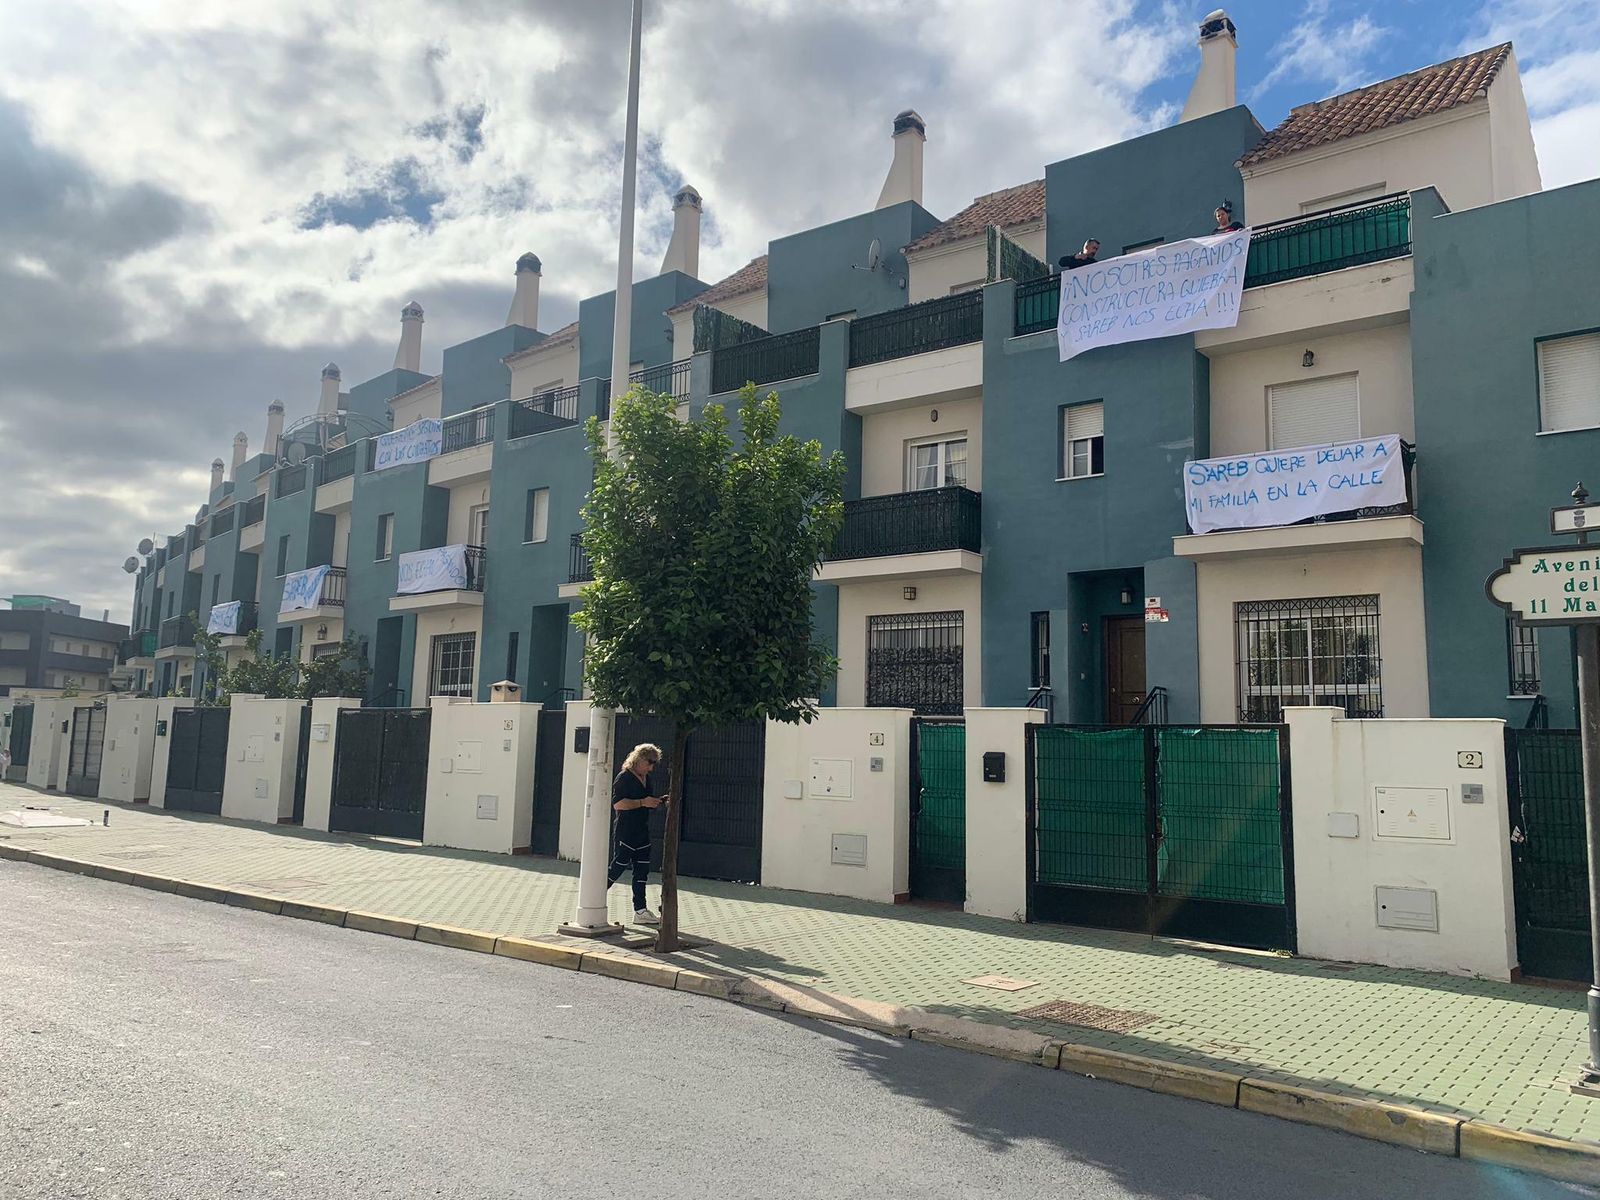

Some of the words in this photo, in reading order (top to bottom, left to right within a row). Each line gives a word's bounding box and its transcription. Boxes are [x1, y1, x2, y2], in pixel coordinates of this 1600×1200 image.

[1173, 238, 1243, 272] PAGAMOS
[1062, 281, 1174, 325] CONSTRUCTORA
[1122, 307, 1156, 328] NOS
[1165, 298, 1208, 320] ECHA
[1189, 460, 1249, 486] SAREB
[1255, 455, 1306, 474] QUIERE
[1317, 444, 1364, 465] DEJAR
[1373, 441, 1387, 457] A
[1191, 497, 1204, 513] MI
[1208, 490, 1259, 509] FAMILIA
[1267, 483, 1289, 501] EN
[1298, 479, 1318, 497] LA
[1328, 470, 1384, 489] CALLE
[1564, 576, 1599, 592] del
[1563, 597, 1597, 612] Ma
[1465, 753, 1474, 766] 2
